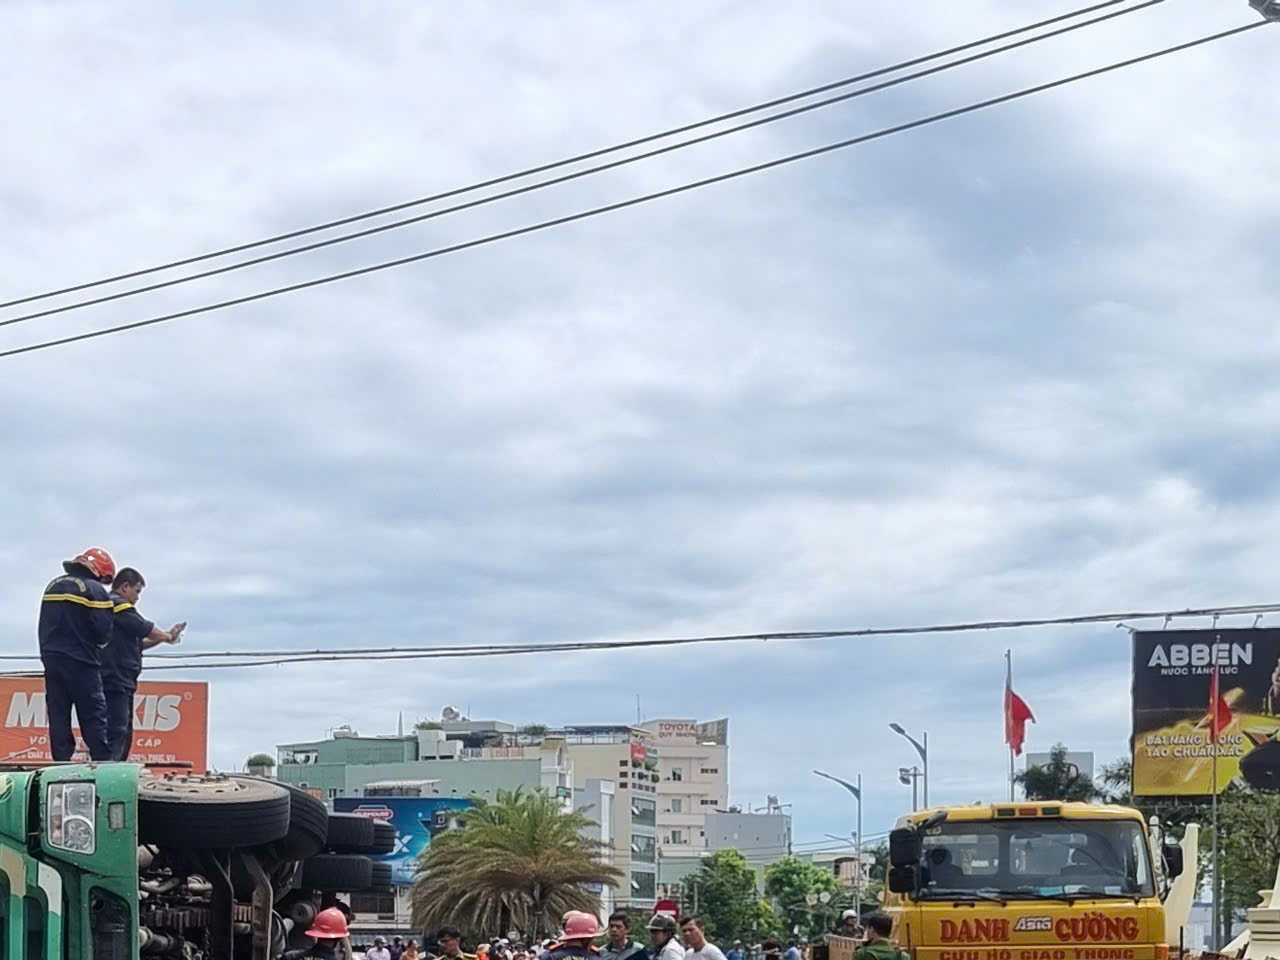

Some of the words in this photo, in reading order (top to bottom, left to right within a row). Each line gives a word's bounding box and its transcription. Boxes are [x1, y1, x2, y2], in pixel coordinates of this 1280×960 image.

[1147, 642, 1253, 667] ABBEN
[5, 691, 181, 732] MXIS
[658, 723, 696, 731] TOYOTA
[939, 917, 1010, 943] DANH
[1054, 911, 1140, 943] CƯỜNG
